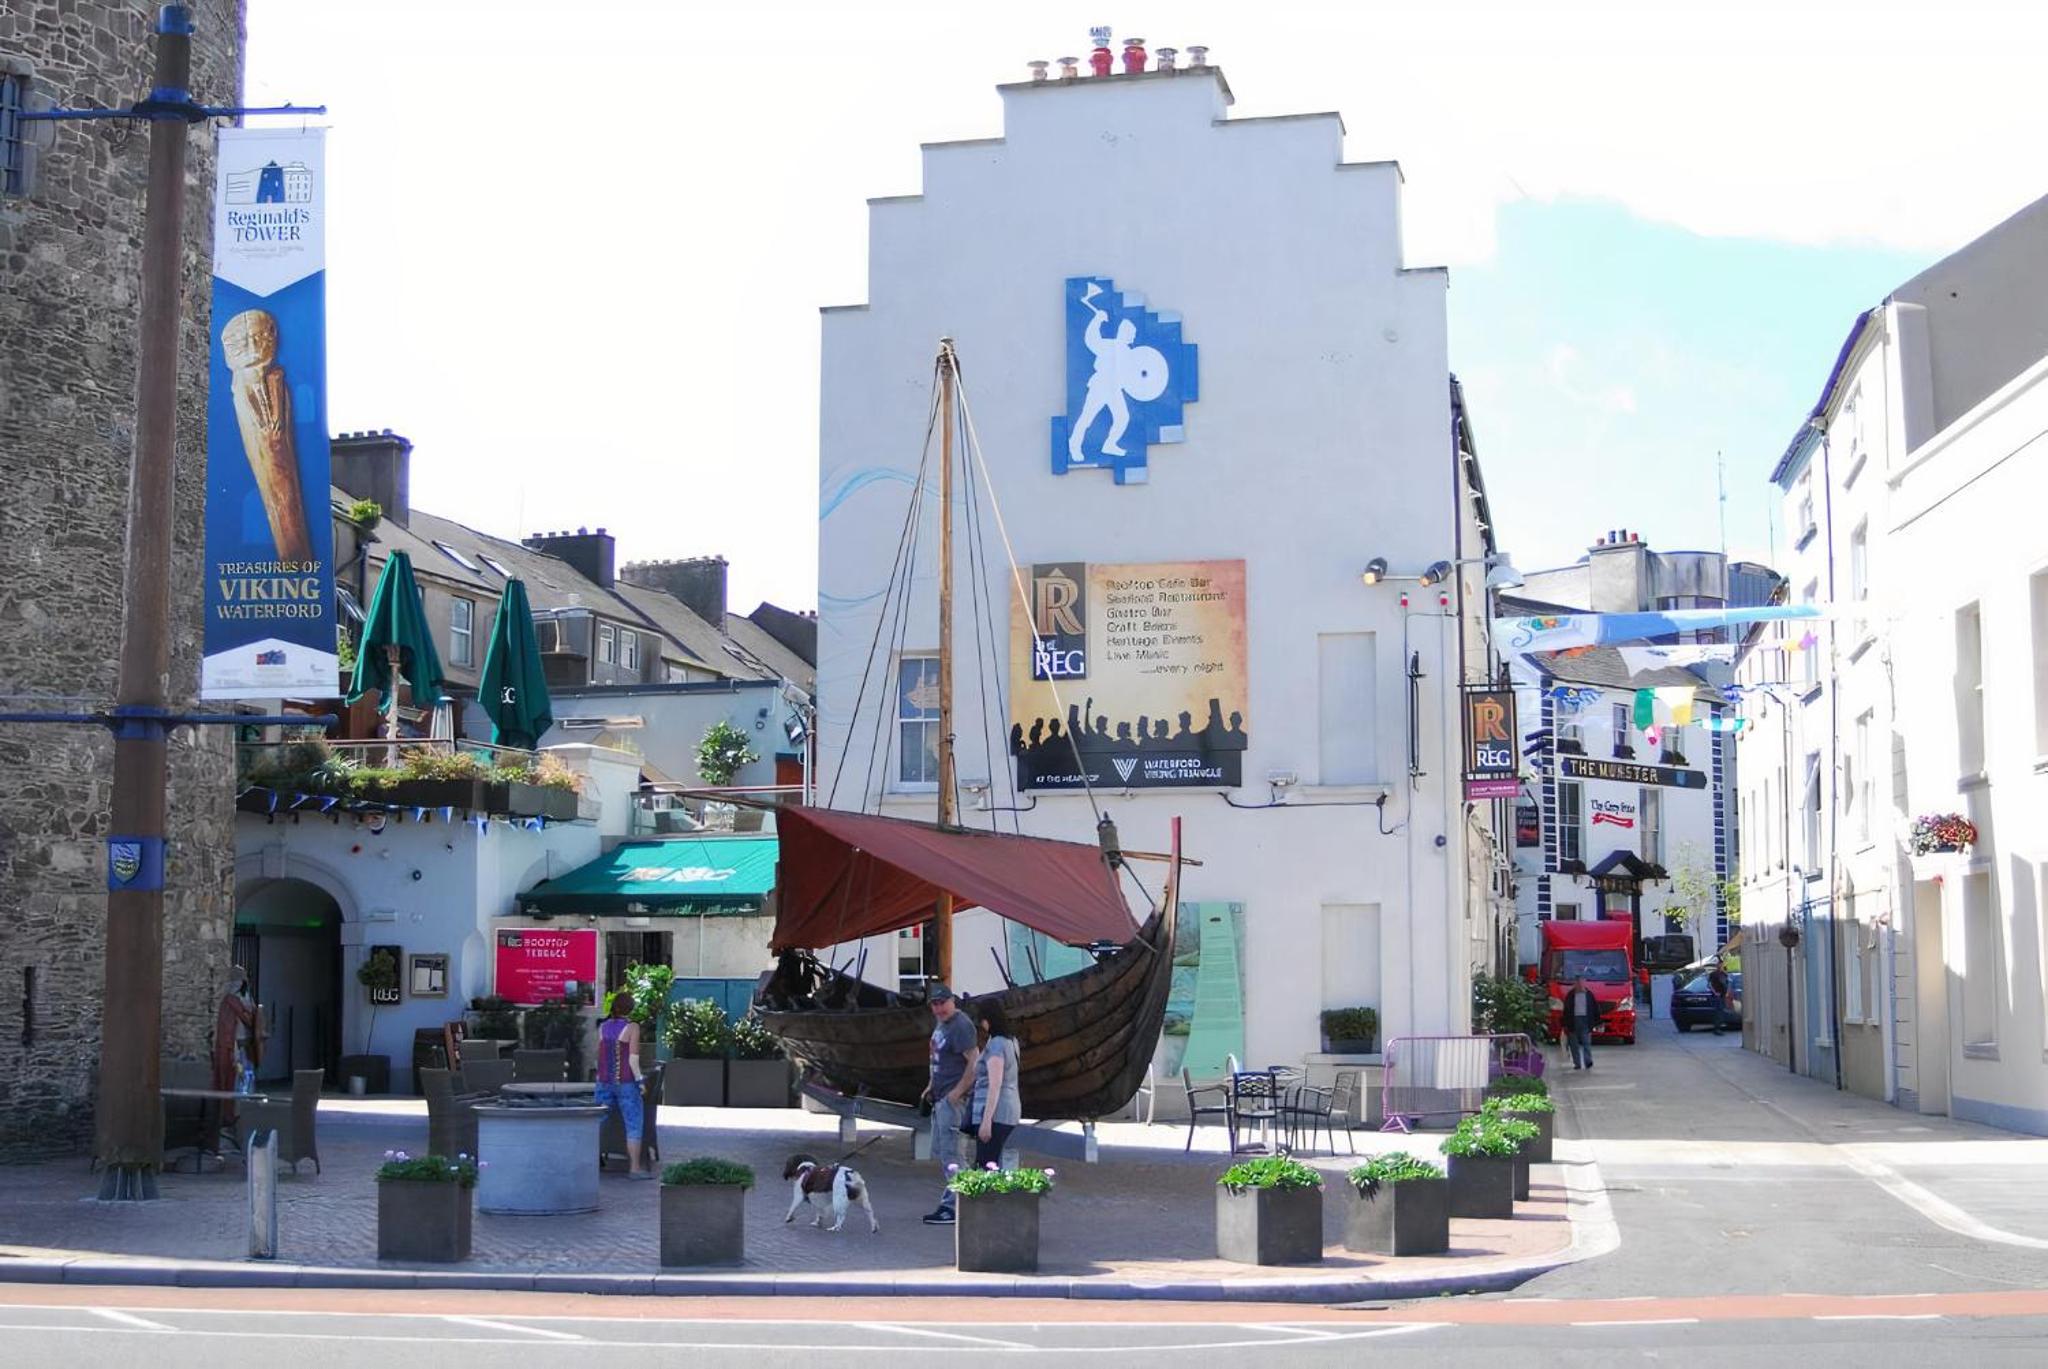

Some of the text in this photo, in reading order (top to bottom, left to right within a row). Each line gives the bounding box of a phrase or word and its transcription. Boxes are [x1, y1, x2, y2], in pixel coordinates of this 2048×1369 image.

[228, 208, 310, 228] Reginald's
[233, 226, 301, 243] TOWER
[217, 561, 322, 575] TREASURES OF
[219, 577, 321, 600] VIKING
[217, 604, 322, 619] WATERFORD
[1106, 606, 1148, 618] Gastro
[1106, 621, 1137, 632] Craft
[1035, 650, 1085, 676] REG
[1106, 650, 1130, 661] Live
[1194, 661, 1224, 674] night
[1476, 750, 1511, 767] REG
[1569, 759, 1659, 783] THE MUNSTER
